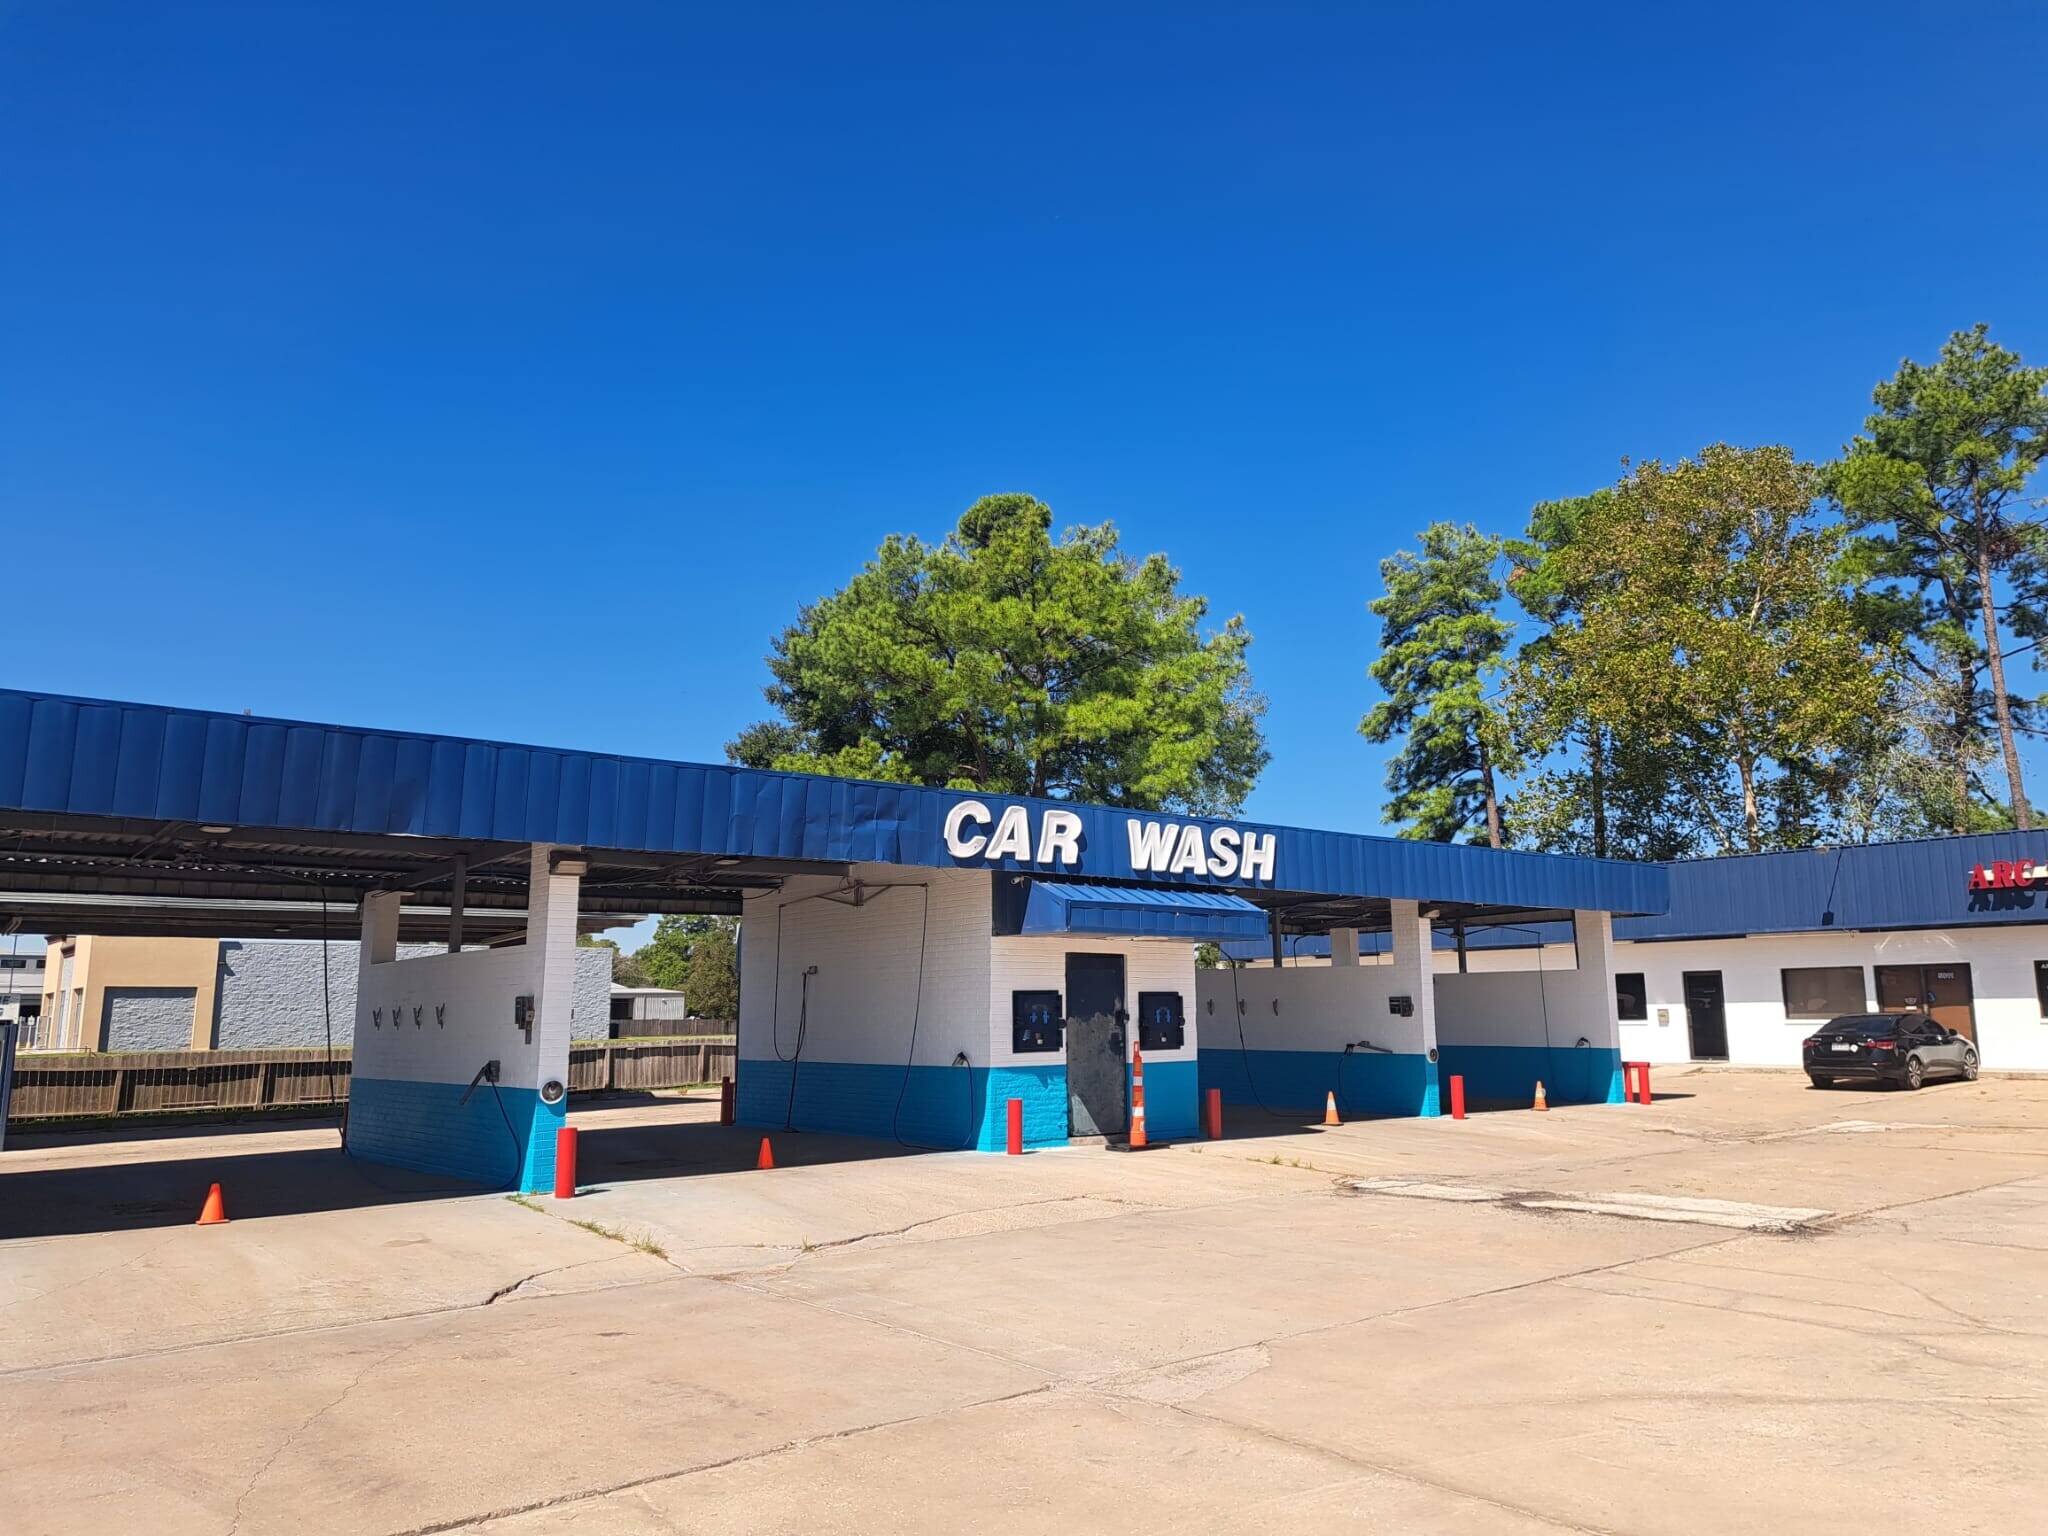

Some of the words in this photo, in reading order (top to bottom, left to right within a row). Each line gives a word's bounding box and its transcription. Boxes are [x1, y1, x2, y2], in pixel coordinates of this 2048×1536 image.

[944, 800, 1083, 865] CAR
[1128, 819, 1276, 881] WASH
[1968, 859, 2036, 890] ARC
